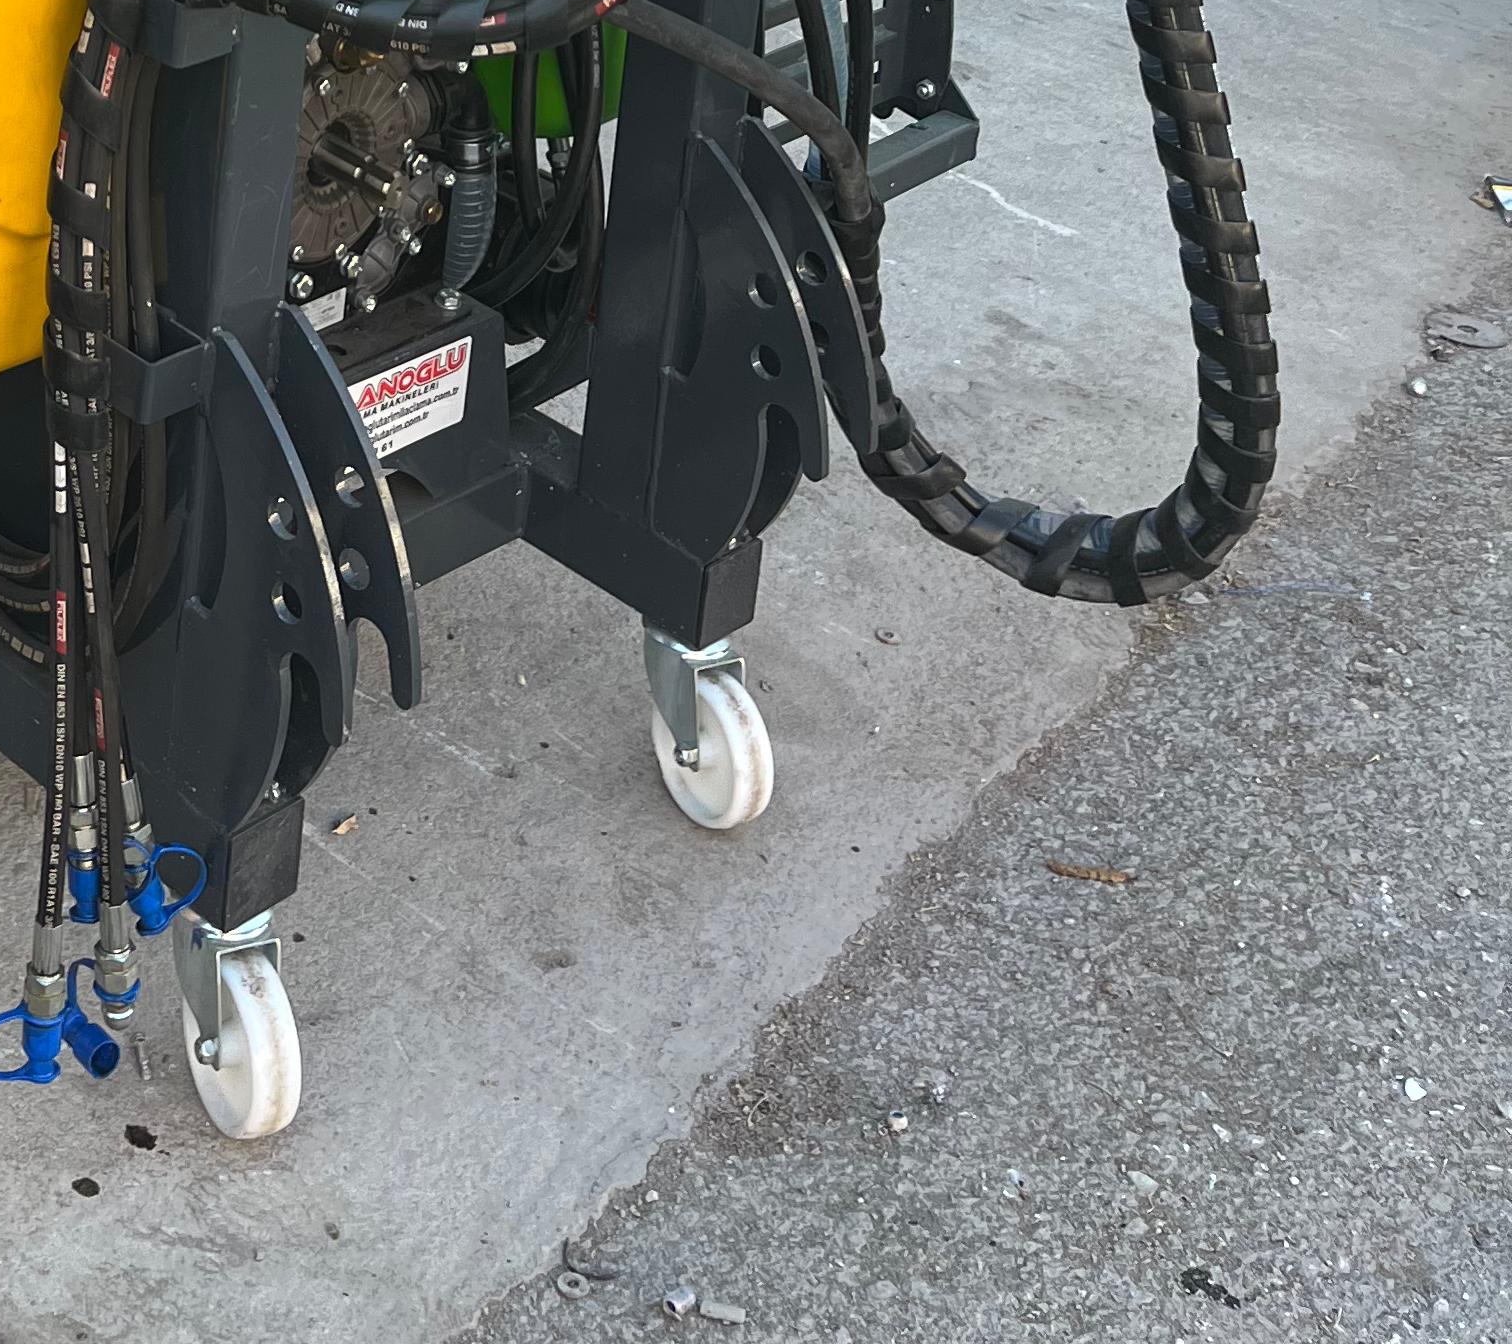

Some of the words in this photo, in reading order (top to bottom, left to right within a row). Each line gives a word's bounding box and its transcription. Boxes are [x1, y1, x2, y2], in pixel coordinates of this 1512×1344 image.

[55, 663, 67, 683] DIN
[55, 683, 66, 700] EN
[55, 722, 66, 743] 1SN
[53, 772, 65, 792] WP
